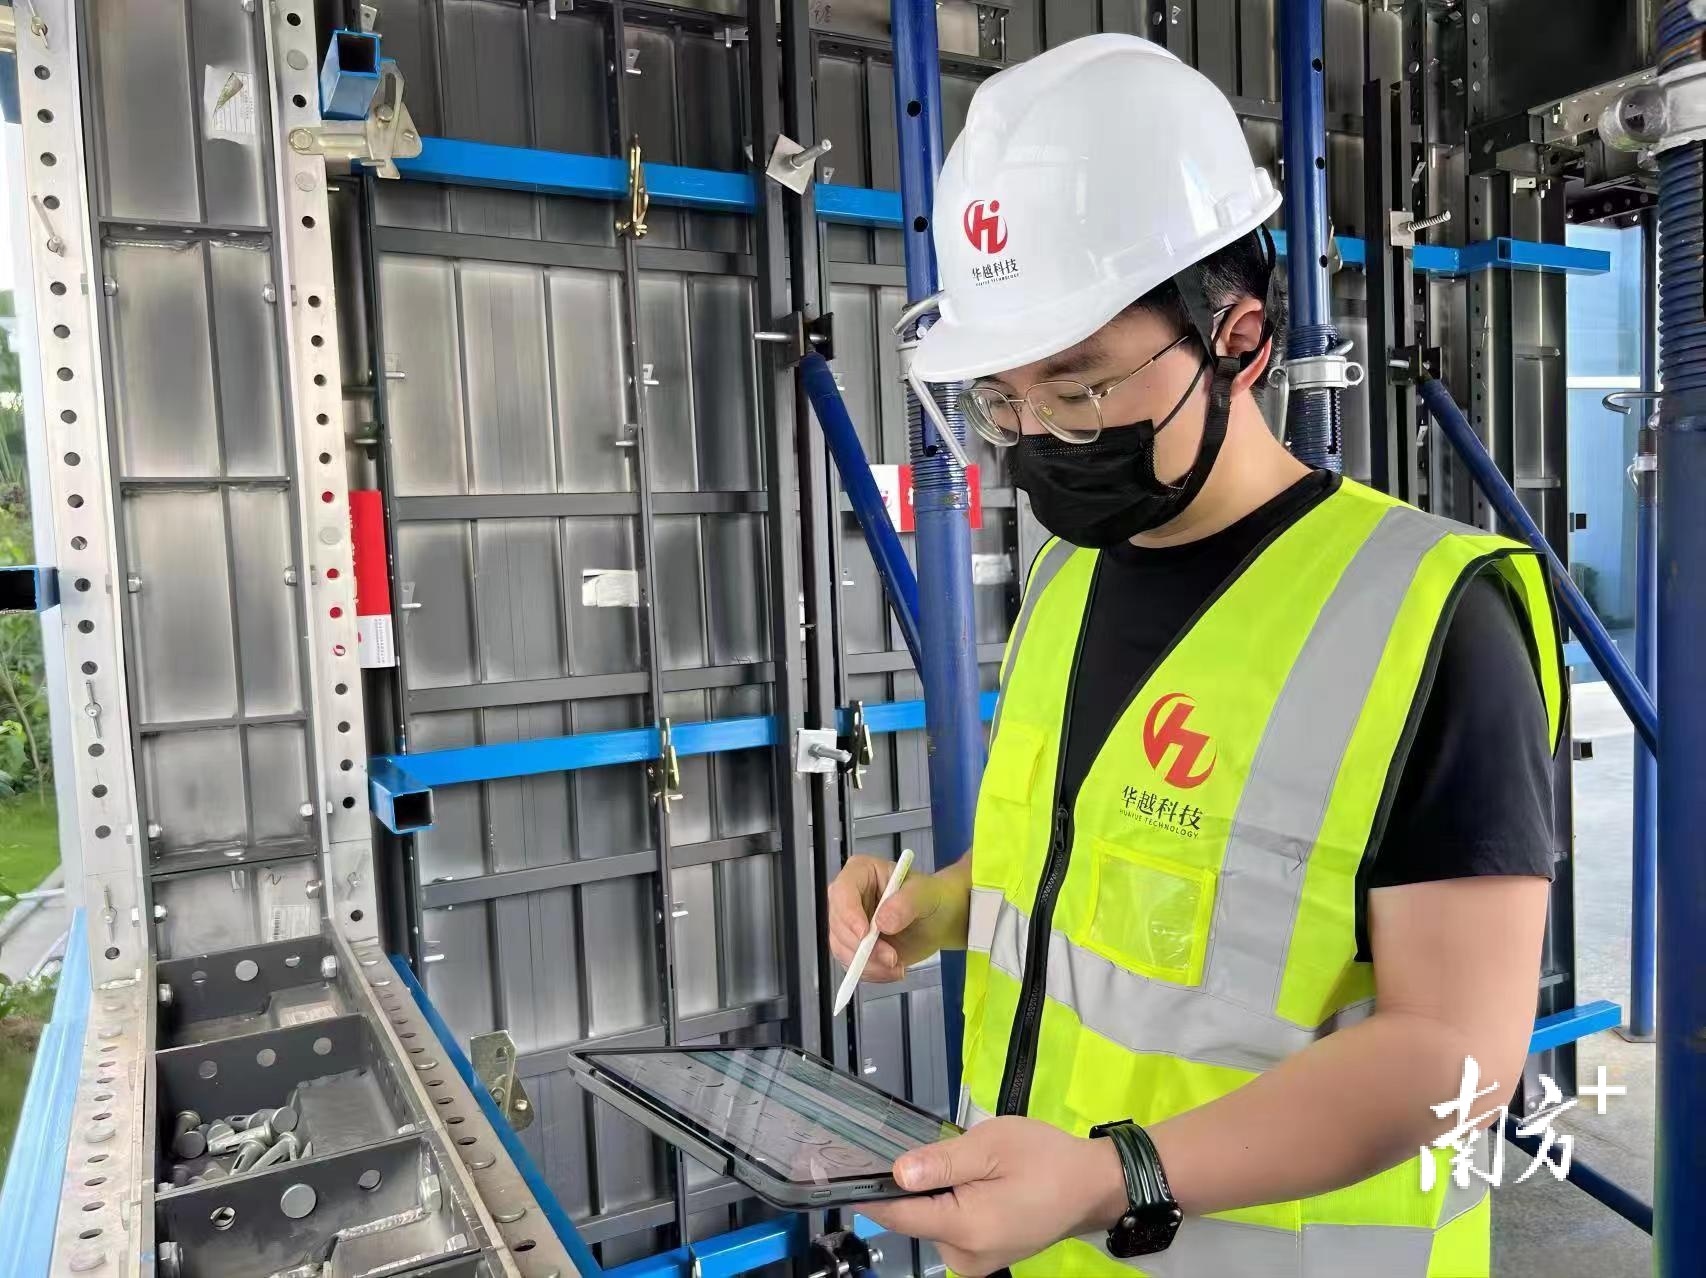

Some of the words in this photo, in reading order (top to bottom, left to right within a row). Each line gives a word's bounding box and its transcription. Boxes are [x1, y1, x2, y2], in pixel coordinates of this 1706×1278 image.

[972, 258, 1019, 281] 华越科技
[1121, 785, 1203, 831] 华越科技
[1144, 817, 1199, 840] TECHNOLOGY
